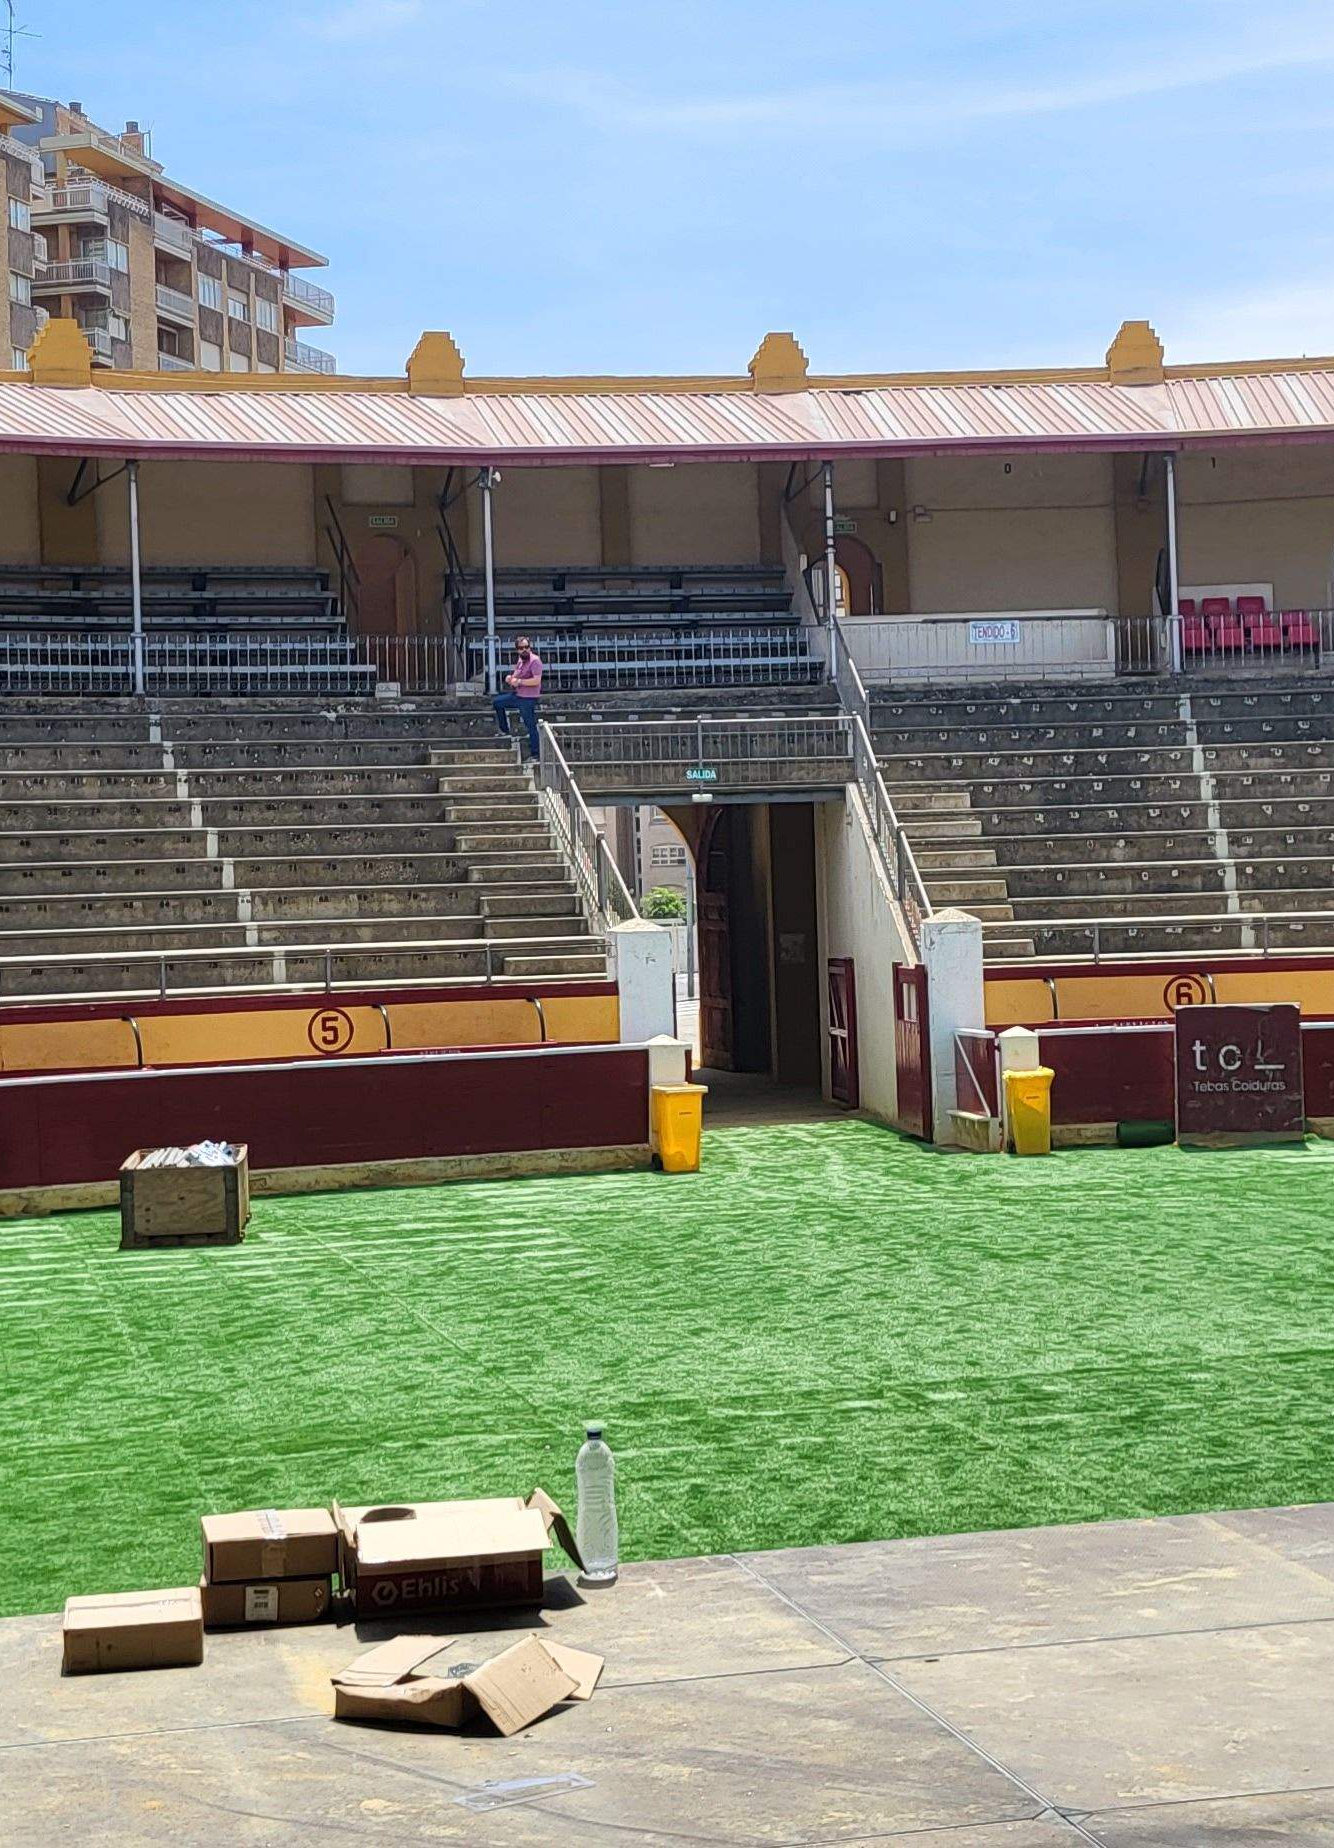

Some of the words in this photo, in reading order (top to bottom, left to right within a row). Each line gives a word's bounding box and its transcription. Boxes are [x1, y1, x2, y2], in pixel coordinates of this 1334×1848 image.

[686, 770, 717, 779] SALIDA
[322, 1016, 338, 1045] 5
[1194, 1081, 1229, 1092] Tebas
[401, 1576, 460, 1599] Ehlis
